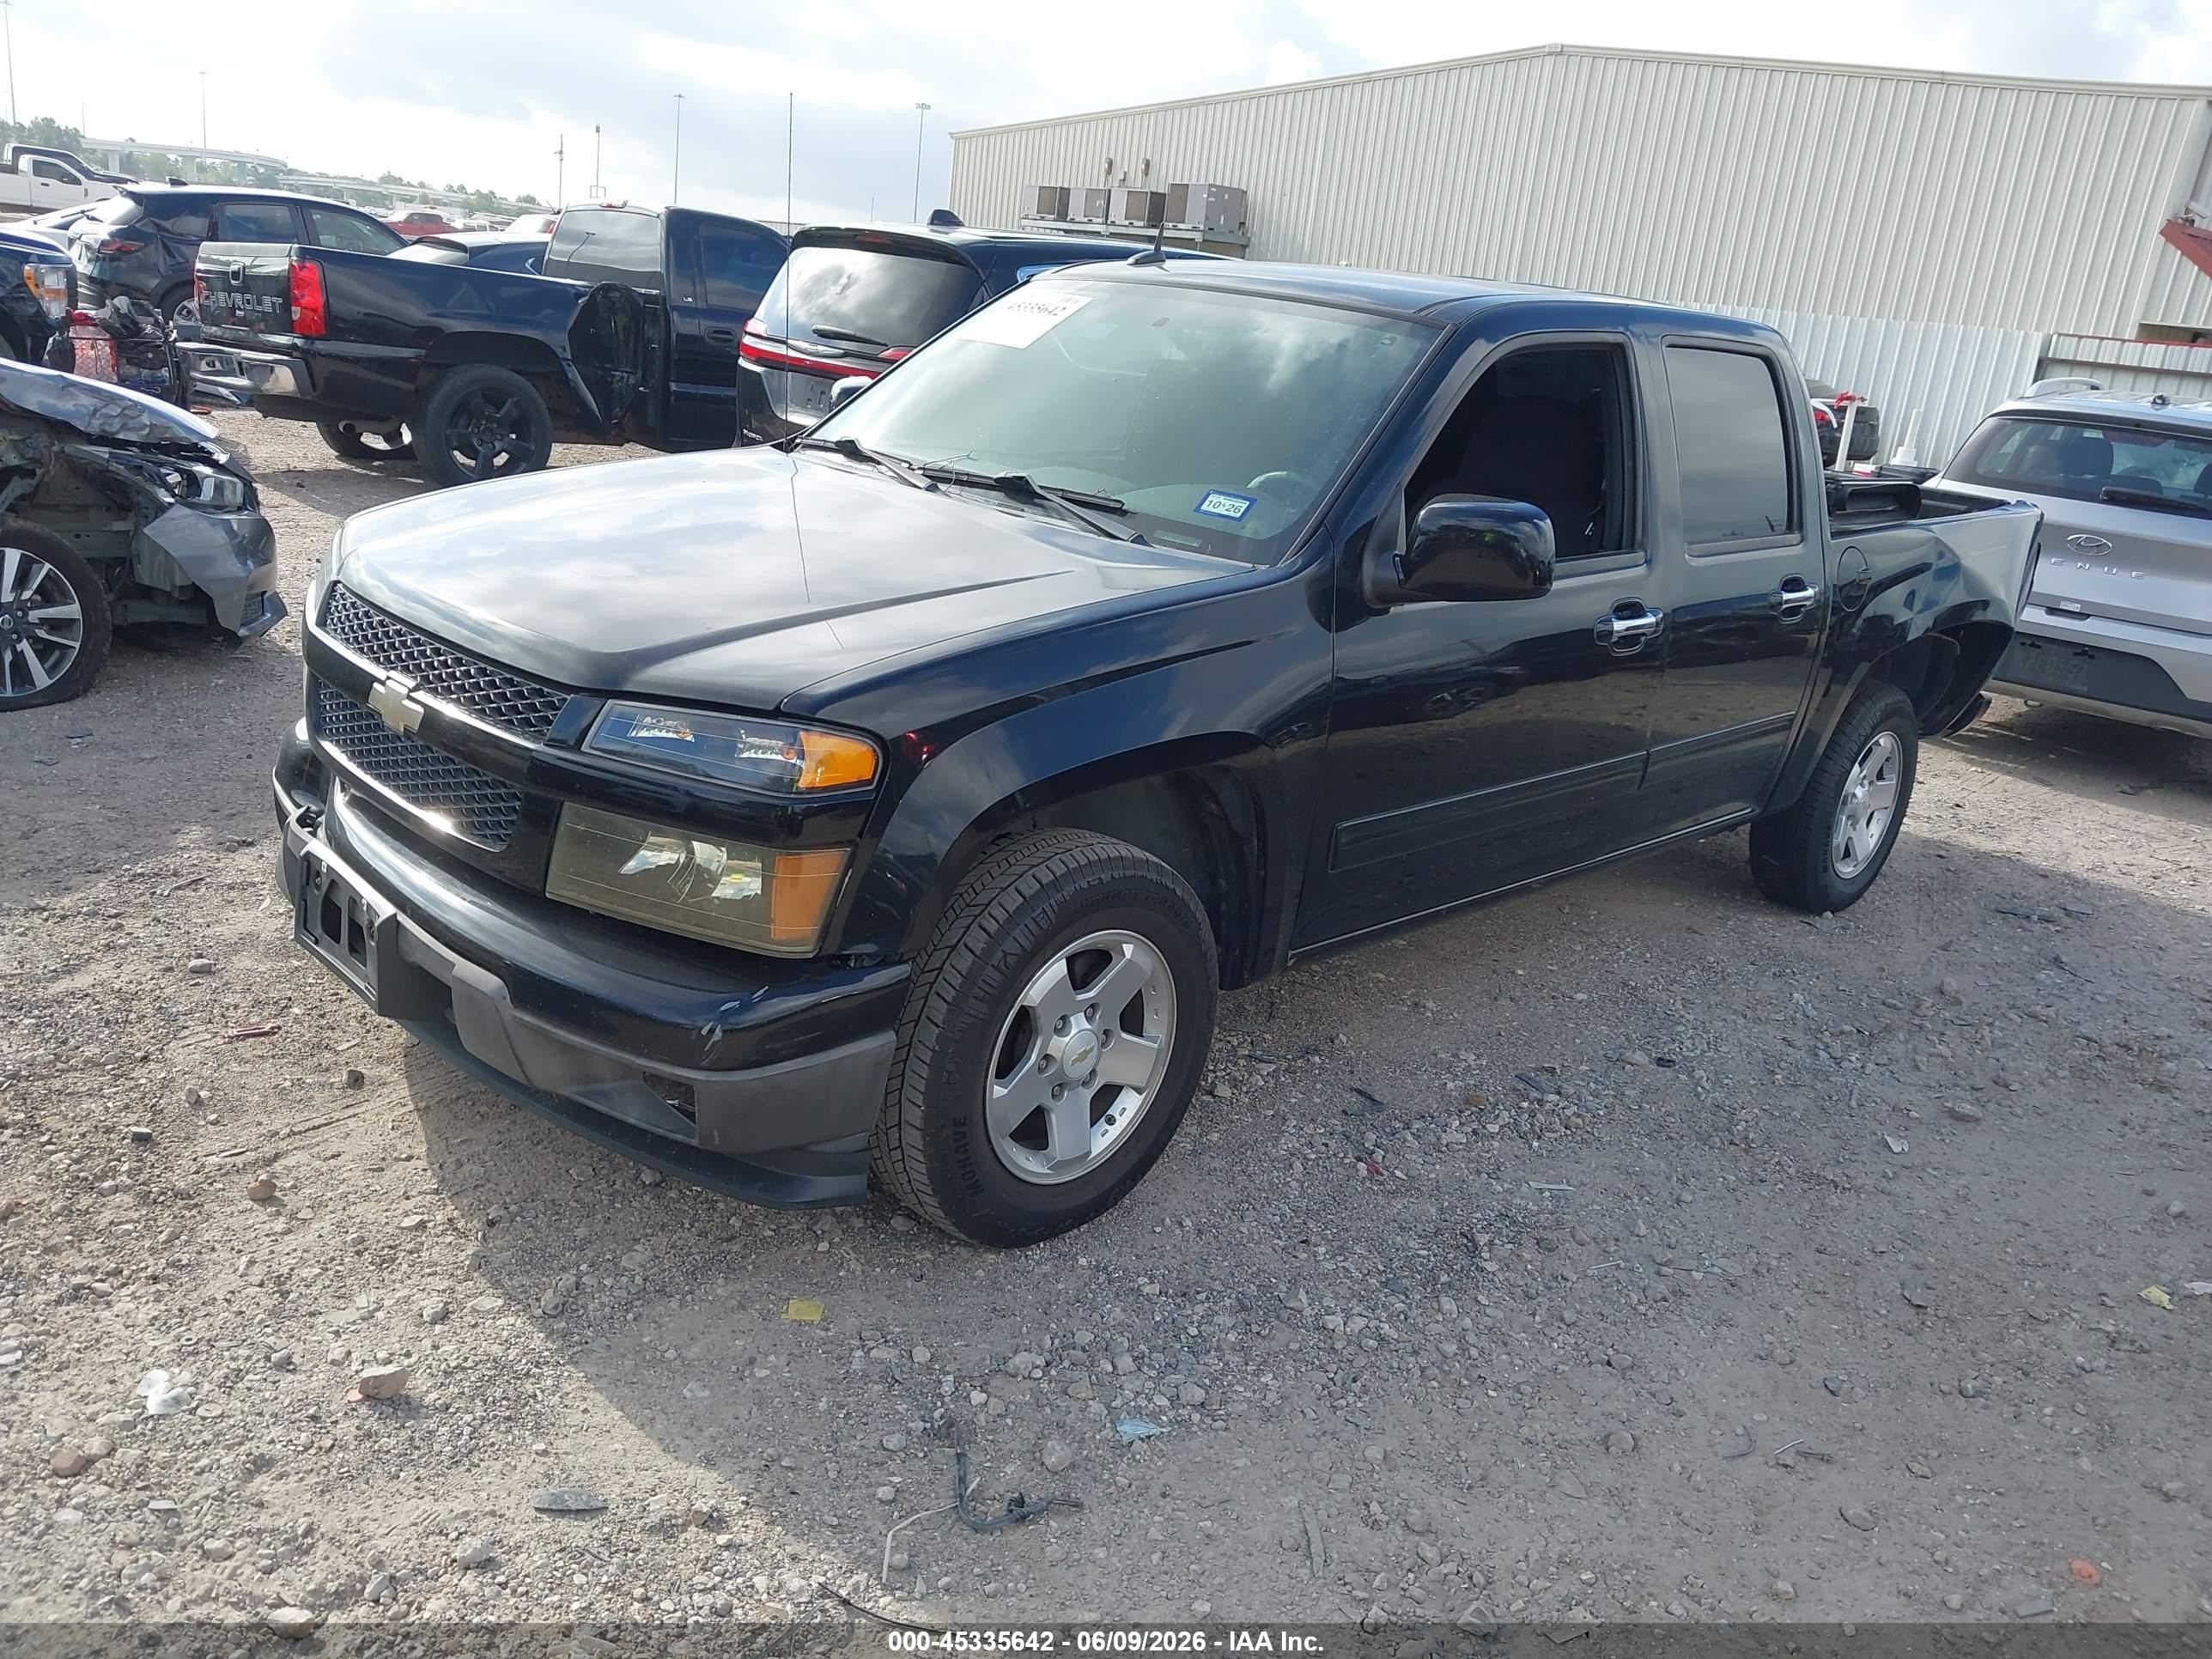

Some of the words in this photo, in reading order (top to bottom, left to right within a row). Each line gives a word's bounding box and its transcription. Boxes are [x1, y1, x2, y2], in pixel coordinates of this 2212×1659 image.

[201, 290, 283, 313] CHEVROLET
[1206, 499, 1222, 509] 10
[1225, 503, 1243, 514] 26
[2051, 557, 2145, 580] ENUE
[952, 1115, 985, 1196] MOHAVE
